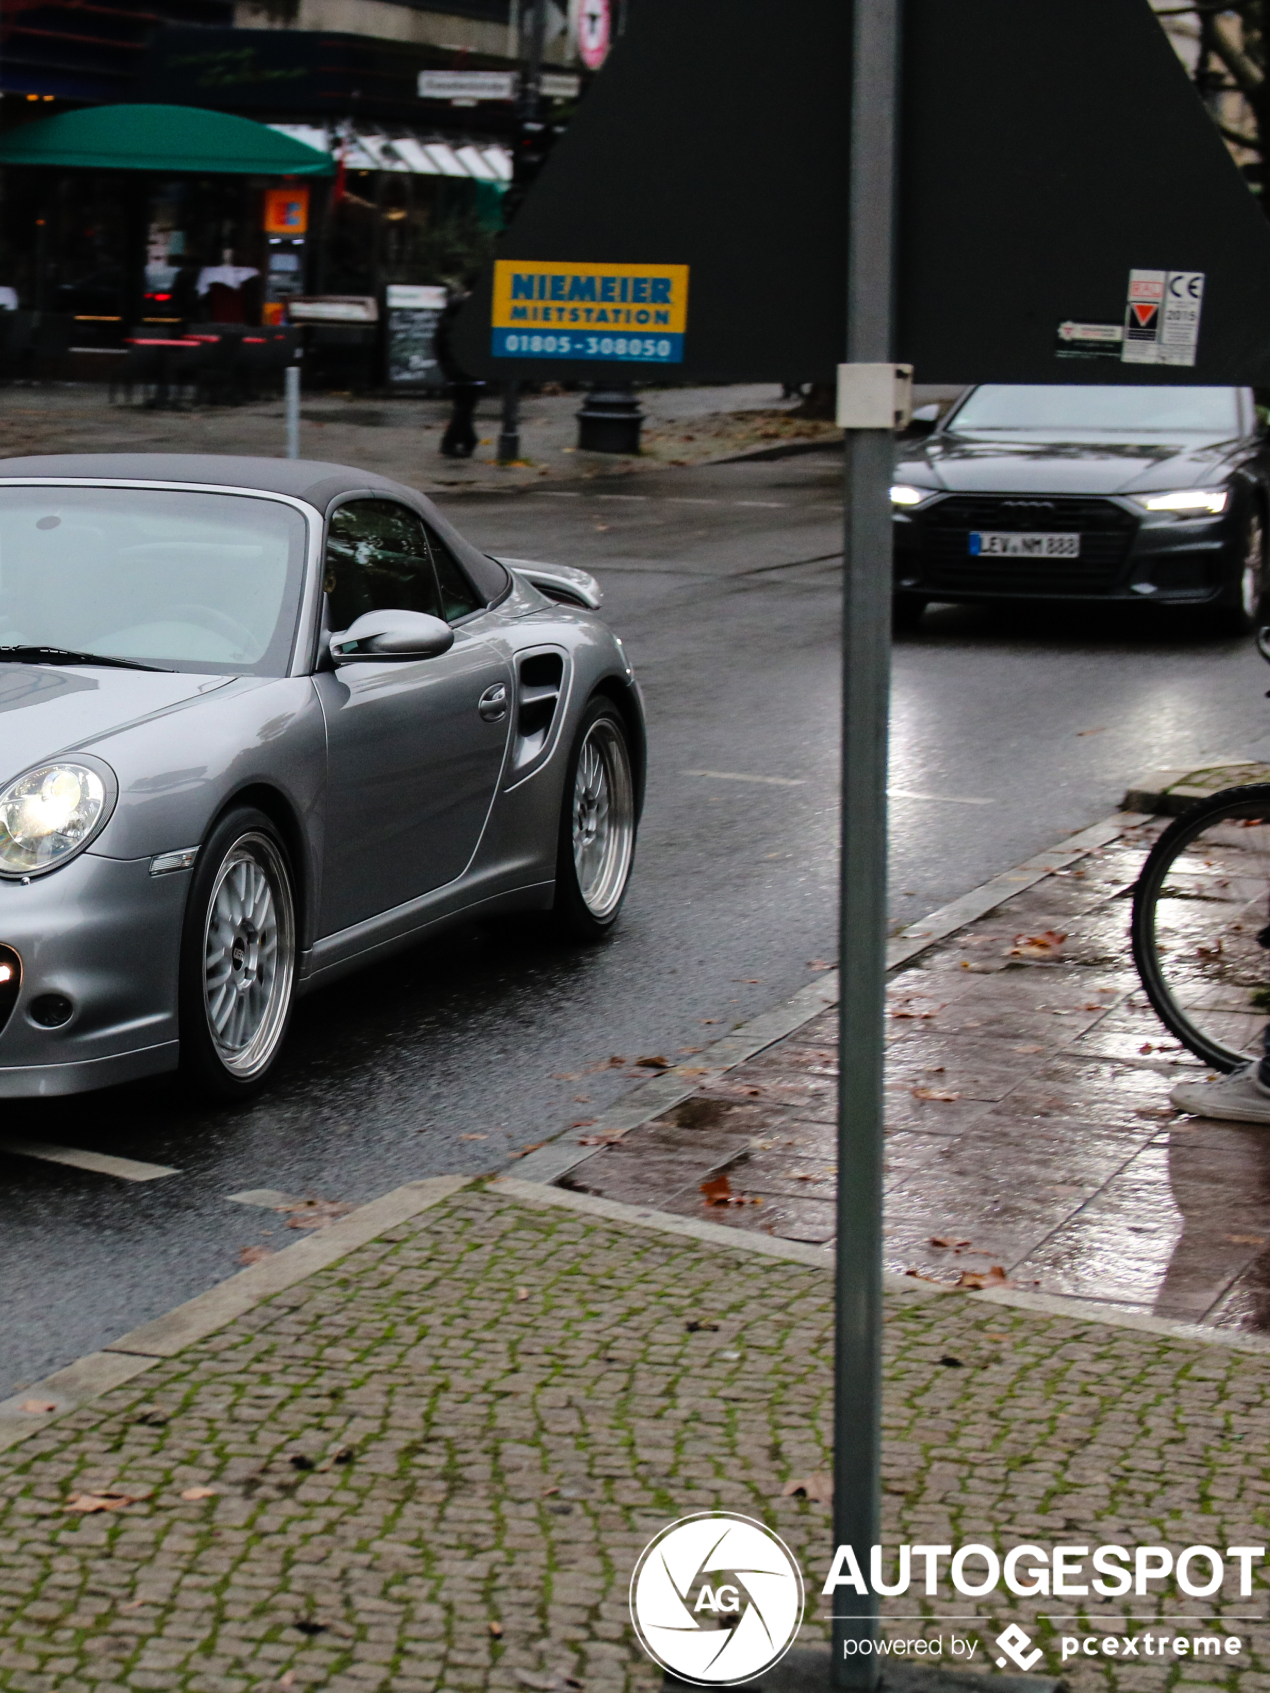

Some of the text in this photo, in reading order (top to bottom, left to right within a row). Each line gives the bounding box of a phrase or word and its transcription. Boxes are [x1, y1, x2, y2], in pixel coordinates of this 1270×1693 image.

[511, 273, 672, 304] NIEMEIER
[510, 305, 670, 326] MIETSTATION
[504, 334, 672, 357] 01805-308050
